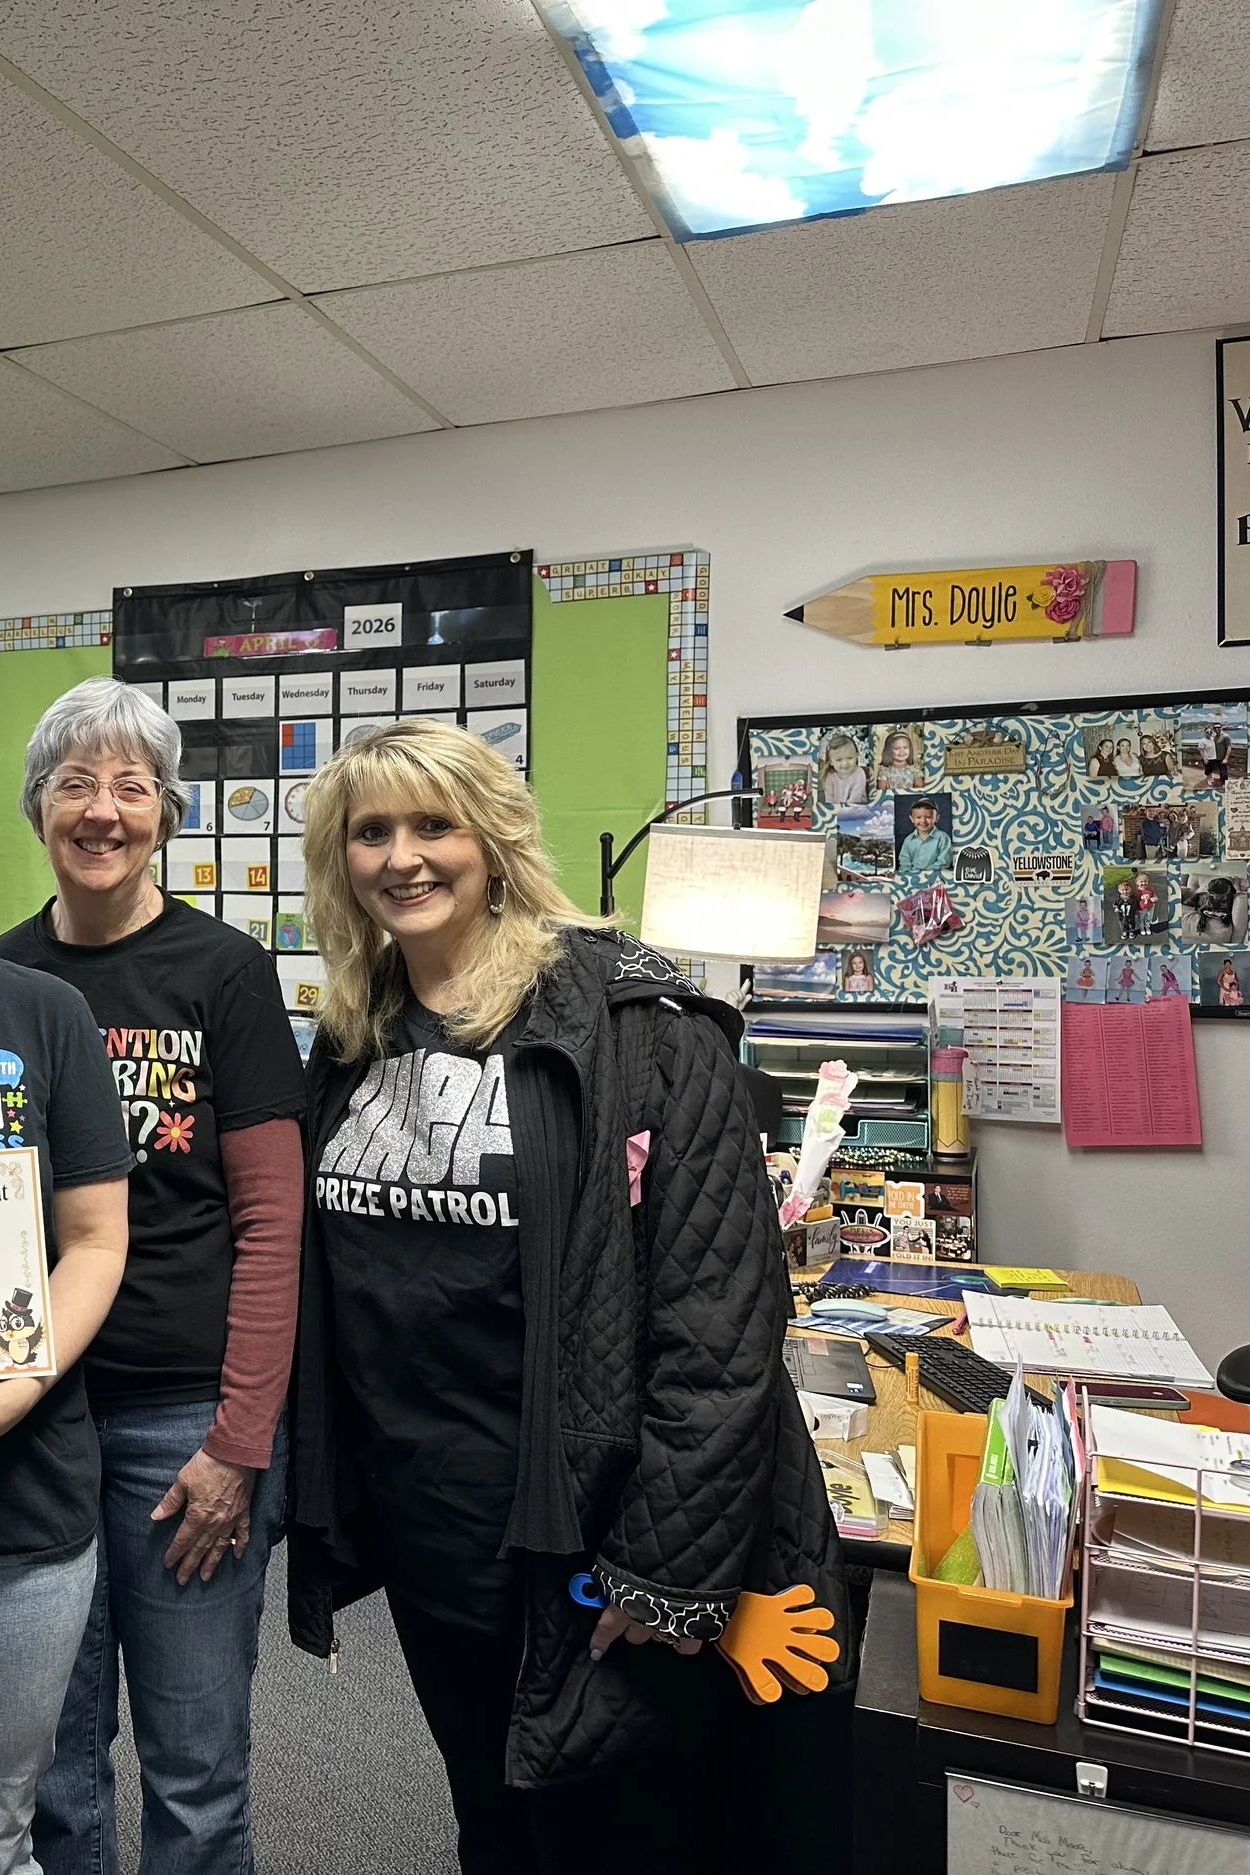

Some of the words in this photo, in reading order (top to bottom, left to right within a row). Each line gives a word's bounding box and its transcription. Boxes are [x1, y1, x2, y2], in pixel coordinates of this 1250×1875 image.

[891, 587, 938, 628] Mrs.
[950, 582, 1017, 628] Doyle
[351, 617, 396, 635] 2026
[239, 638, 297, 652] APRIL
[177, 695, 206, 704] Monday
[232, 692, 265, 701] Tuesday
[282, 689, 329, 699] Wednesday
[348, 686, 387, 695] Thursday
[417, 682, 445, 692] Friday
[474, 677, 516, 689] Saturday
[515, 755, 524, 765] 4
[206, 822, 213, 831] 6
[263, 822, 270, 831] 7
[1013, 856, 1072, 870] YELLOWSTONE
[197, 867, 211, 882] 13
[250, 869, 266, 885] 14
[251, 923, 265, 941] 21
[299, 986, 318, 1004] 29
[99, 1028, 202, 1066] NTION
[112, 1060, 196, 1103] RING
[316, 1176, 385, 1216] PRIZE
[389, 1186, 519, 1227] PATROL
[893, 1218, 911, 1226] YOU
[999, 1825, 1022, 1837] Dear
